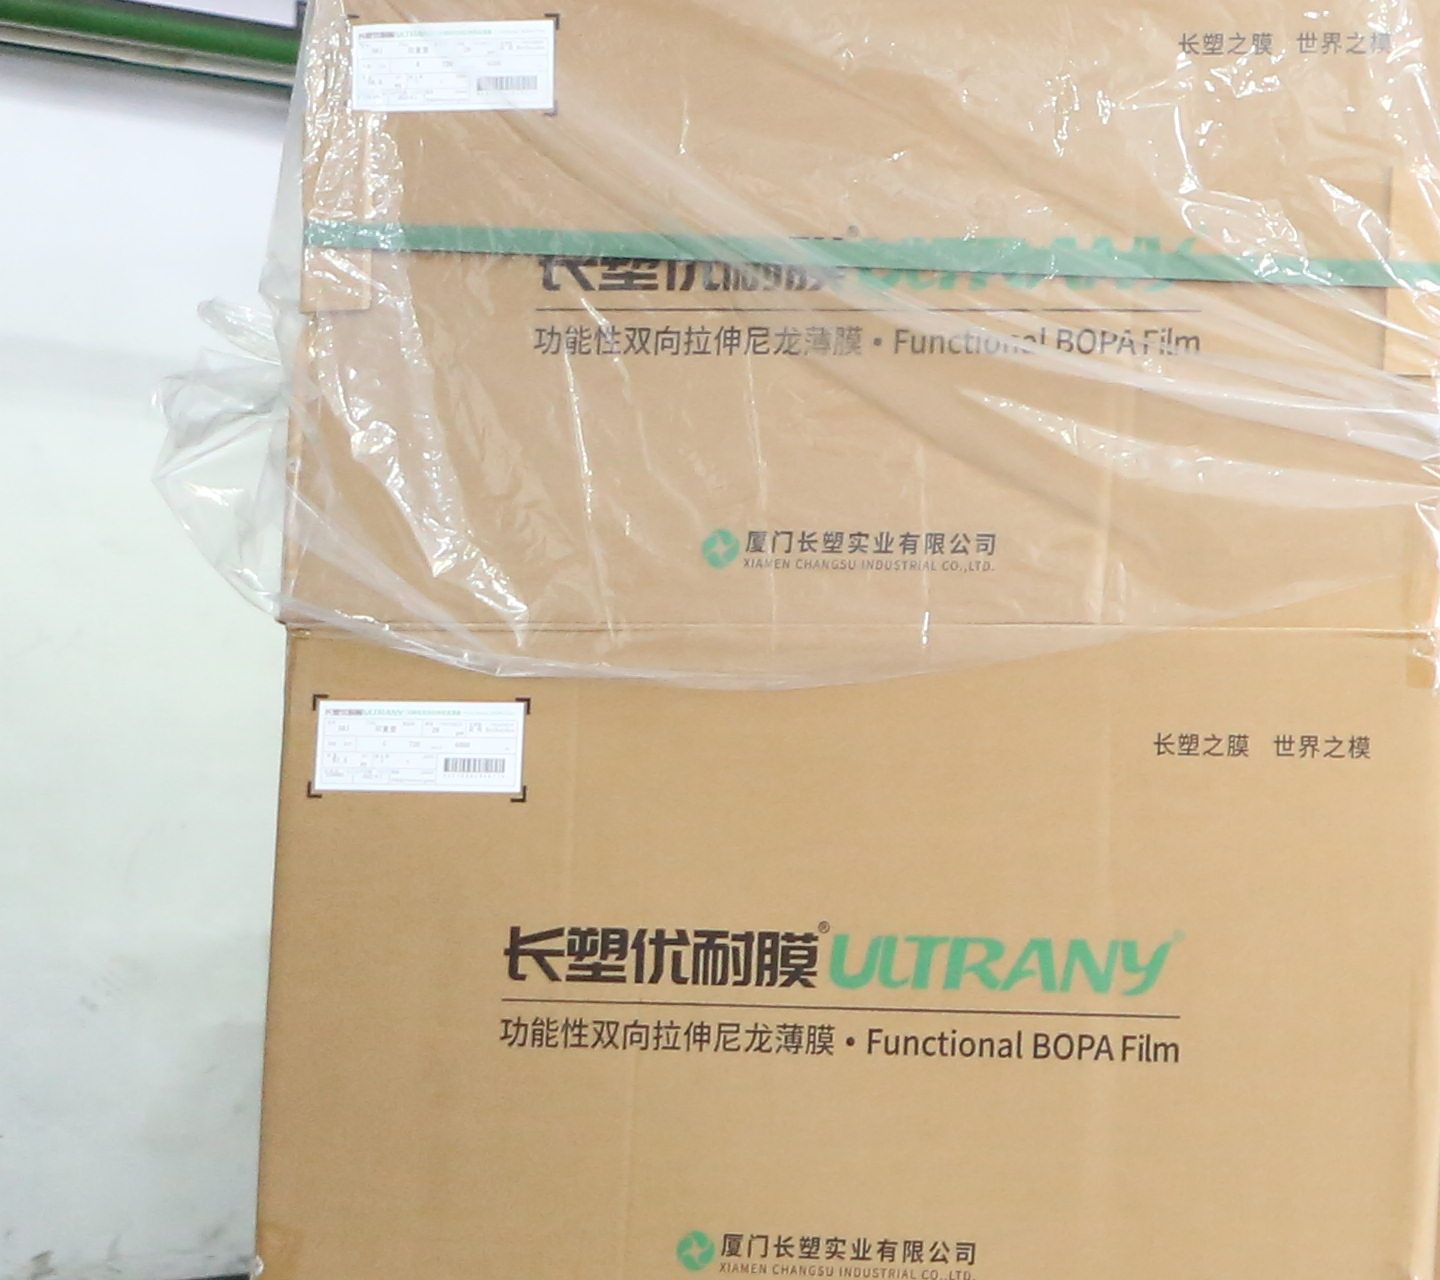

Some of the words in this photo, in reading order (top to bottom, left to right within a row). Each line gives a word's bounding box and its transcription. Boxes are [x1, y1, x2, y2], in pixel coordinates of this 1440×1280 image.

[1178, 32, 1274, 56] 长塑之膜
[1296, 32, 1394, 56] 世界之模
[533, 325, 863, 357] 功能性双向拉伸尼龙薄膜
[1056, 326, 1137, 357] BOPA
[1143, 327, 1202, 356] Film
[744, 530, 997, 557] 厦门长塑实业有限公司
[743, 558, 791, 570] XIAMEN
[795, 558, 857, 571] CHANGSU
[861, 559, 937, 572] INDUSTRIAL
[1153, 732, 1250, 758] 长塑之膜
[1273, 734, 1373, 760] 世界之模
[503, 925, 820, 989] 长塑优耐膜
[828, 933, 1174, 997] ULTRANY
[500, 1016, 837, 1056] 功能性双向拉伸尼龙薄膜
[866, 1028, 1024, 1060] Functional
[1032, 1032, 1115, 1062] BOPA
[1121, 1034, 1181, 1064] Film
[720, 1233, 977, 1266] 厦门长塑实业有限公司
[719, 1262, 768, 1275] XIAMEN
[772, 1263, 835, 1278] CHANGSU
